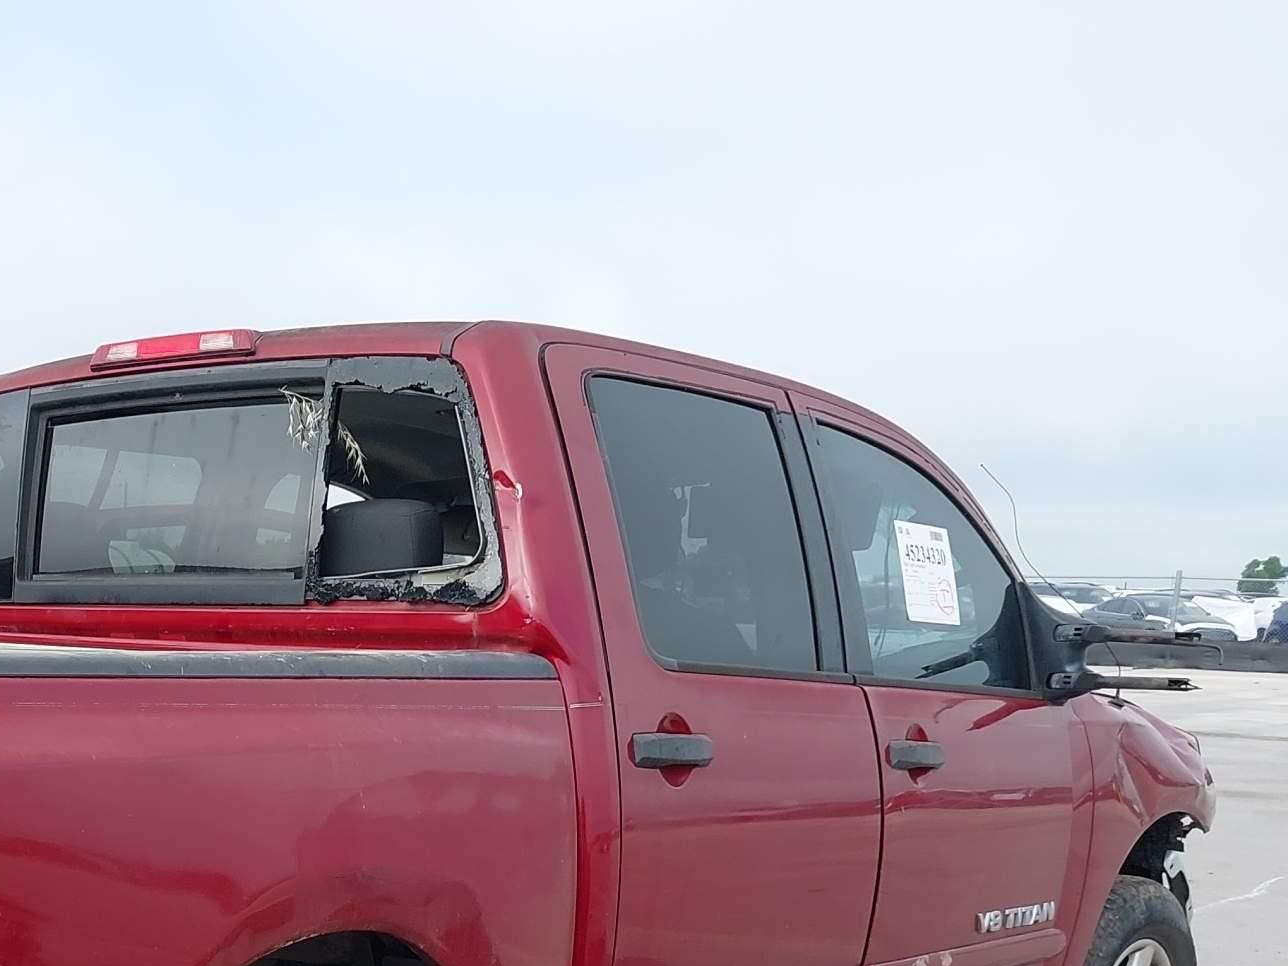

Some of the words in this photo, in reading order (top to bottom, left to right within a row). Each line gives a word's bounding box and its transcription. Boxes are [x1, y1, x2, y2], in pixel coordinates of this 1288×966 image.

[905, 543, 947, 567] 45234320
[976, 910, 1002, 934] V8
[1004, 900, 1056, 929] TITAN
